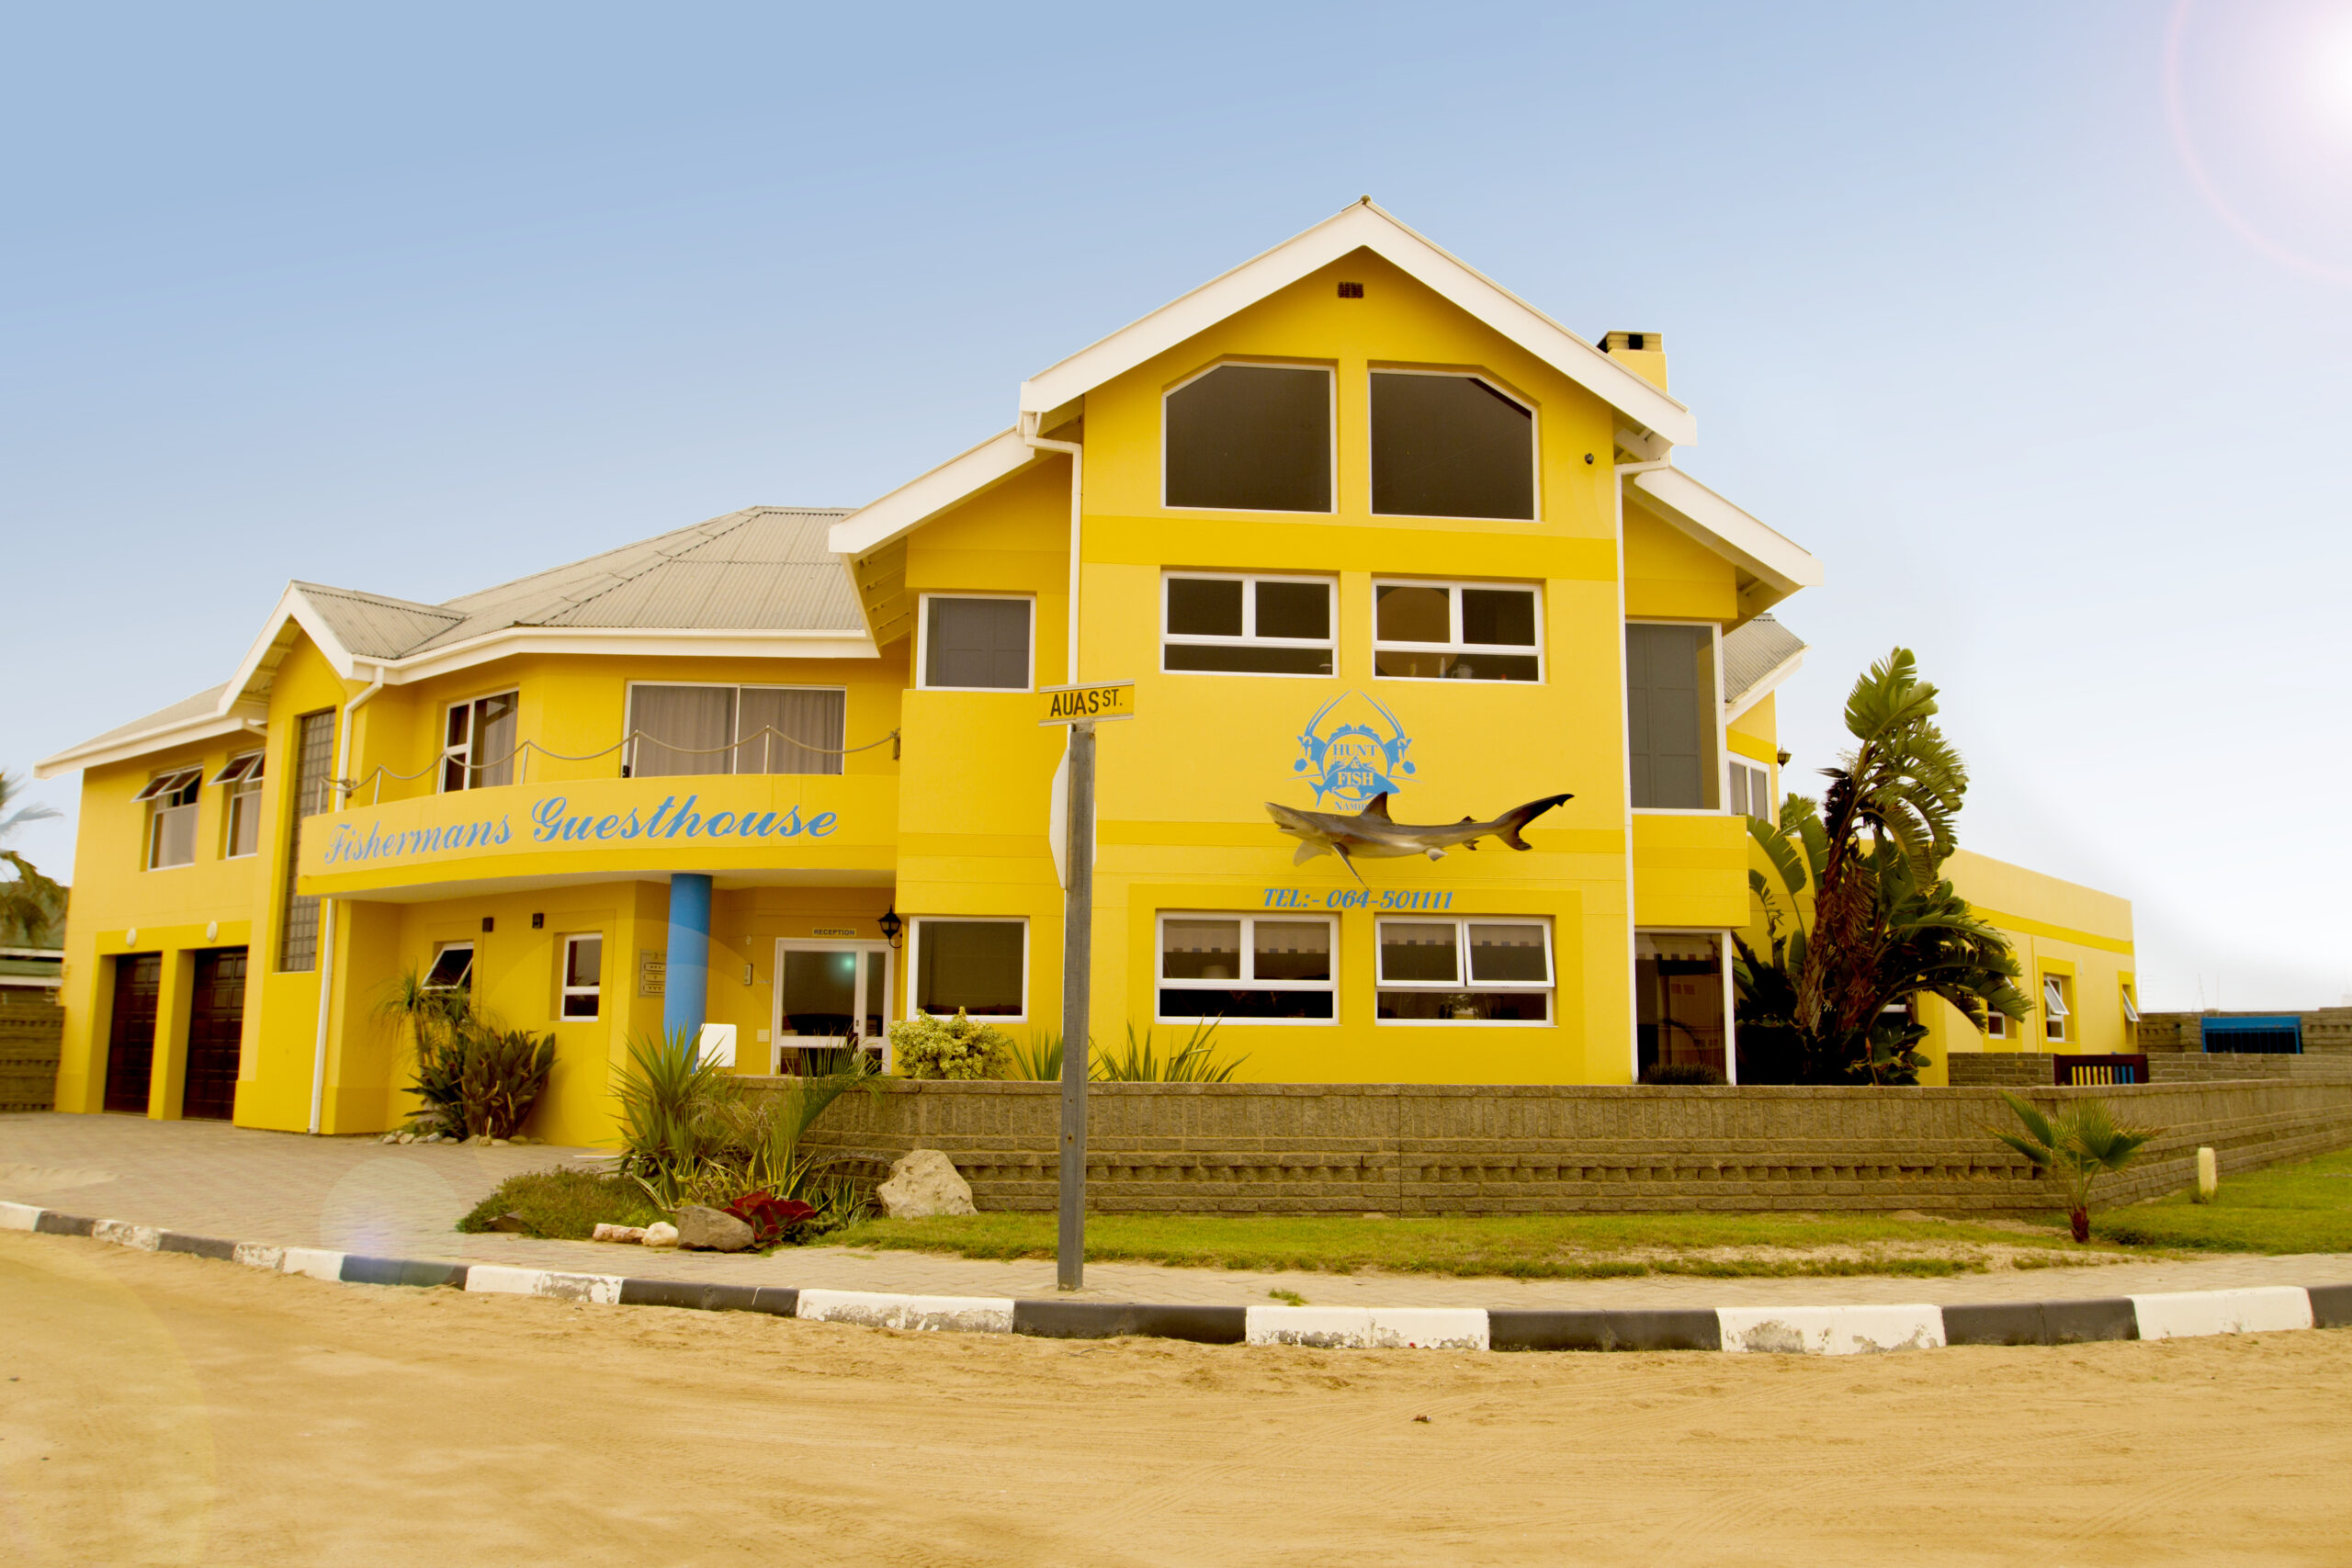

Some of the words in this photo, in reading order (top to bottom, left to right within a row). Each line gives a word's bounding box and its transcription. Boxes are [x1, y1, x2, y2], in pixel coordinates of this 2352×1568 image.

[1050, 690, 1099, 717] AUAS
[1102, 688, 1123, 707] ST.
[1333, 744, 1378, 757] HUNT
[1351, 759, 1360, 769] &
[1338, 772, 1374, 785] FISH
[324, 814, 514, 865] Fishermans
[531, 794, 838, 842] Guesthouse
[1326, 889, 1453, 909] 064-501111
